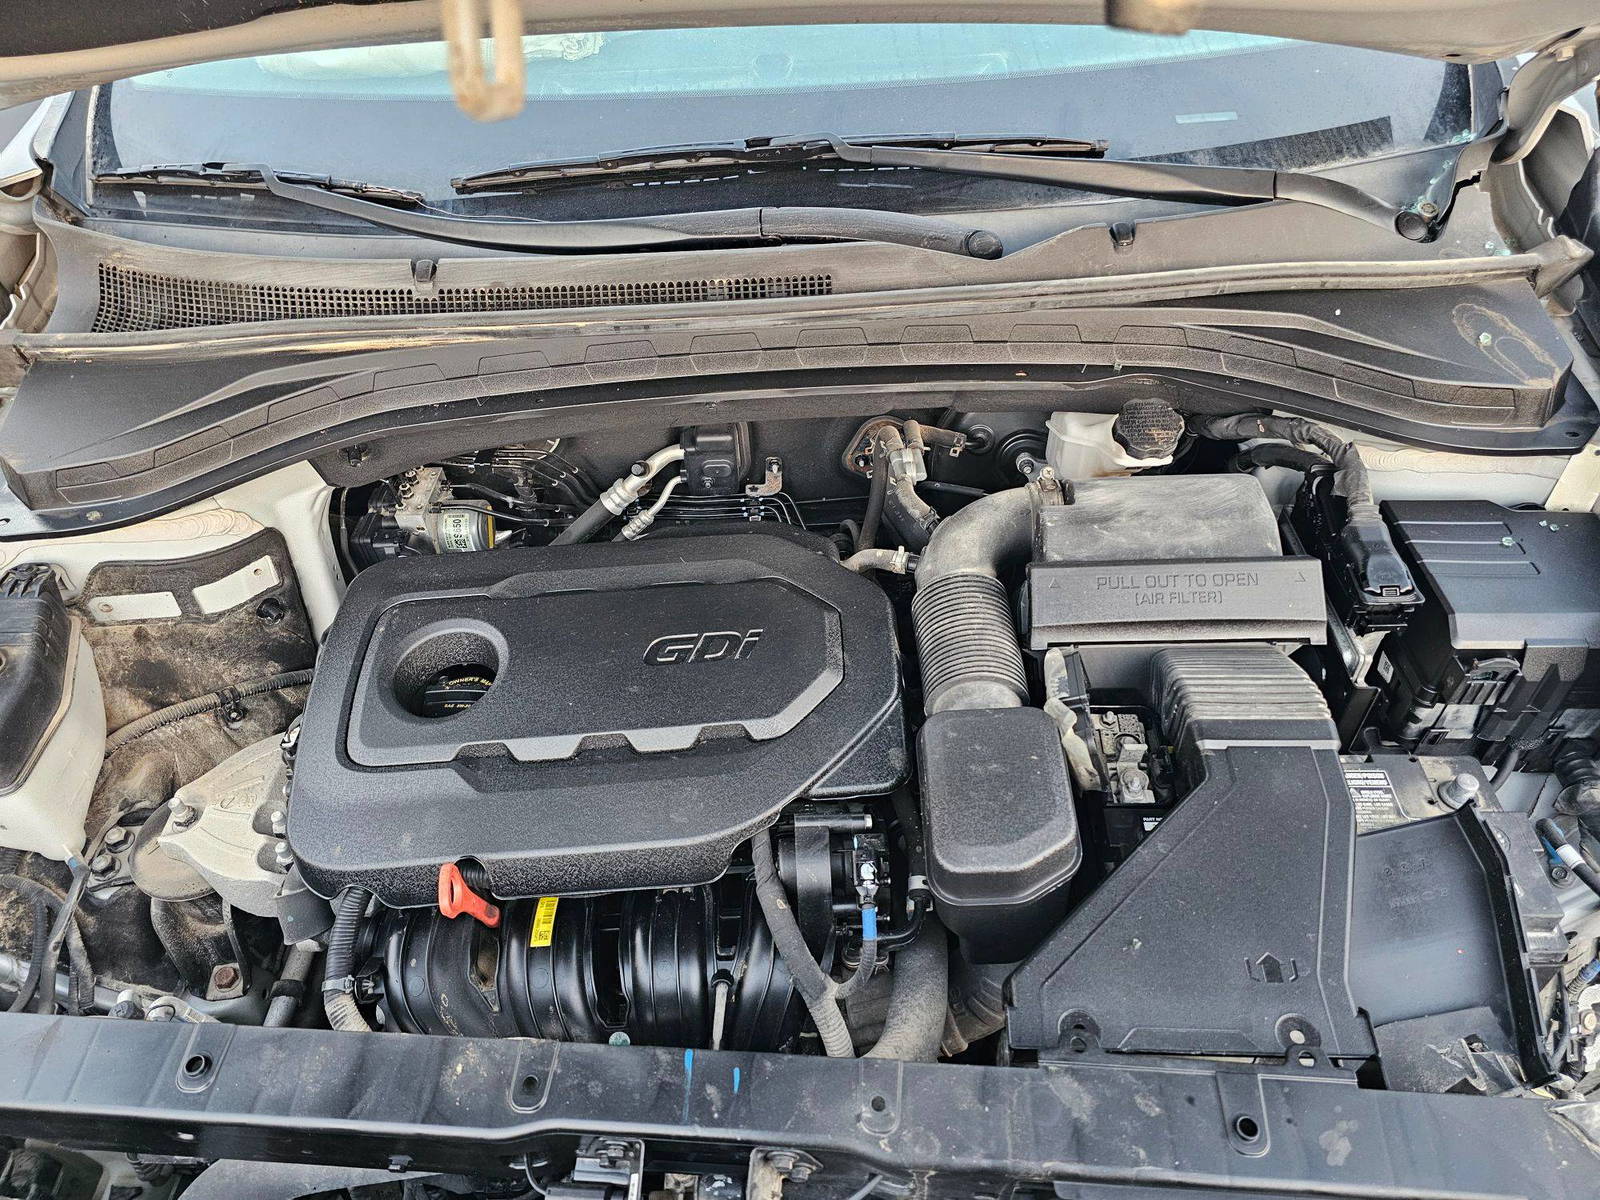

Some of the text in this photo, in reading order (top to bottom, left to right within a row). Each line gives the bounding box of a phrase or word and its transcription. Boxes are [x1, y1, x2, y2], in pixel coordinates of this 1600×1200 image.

[1096, 572, 1259, 590] PULL OUT TO OPEN
[643, 627, 763, 665] GDi
